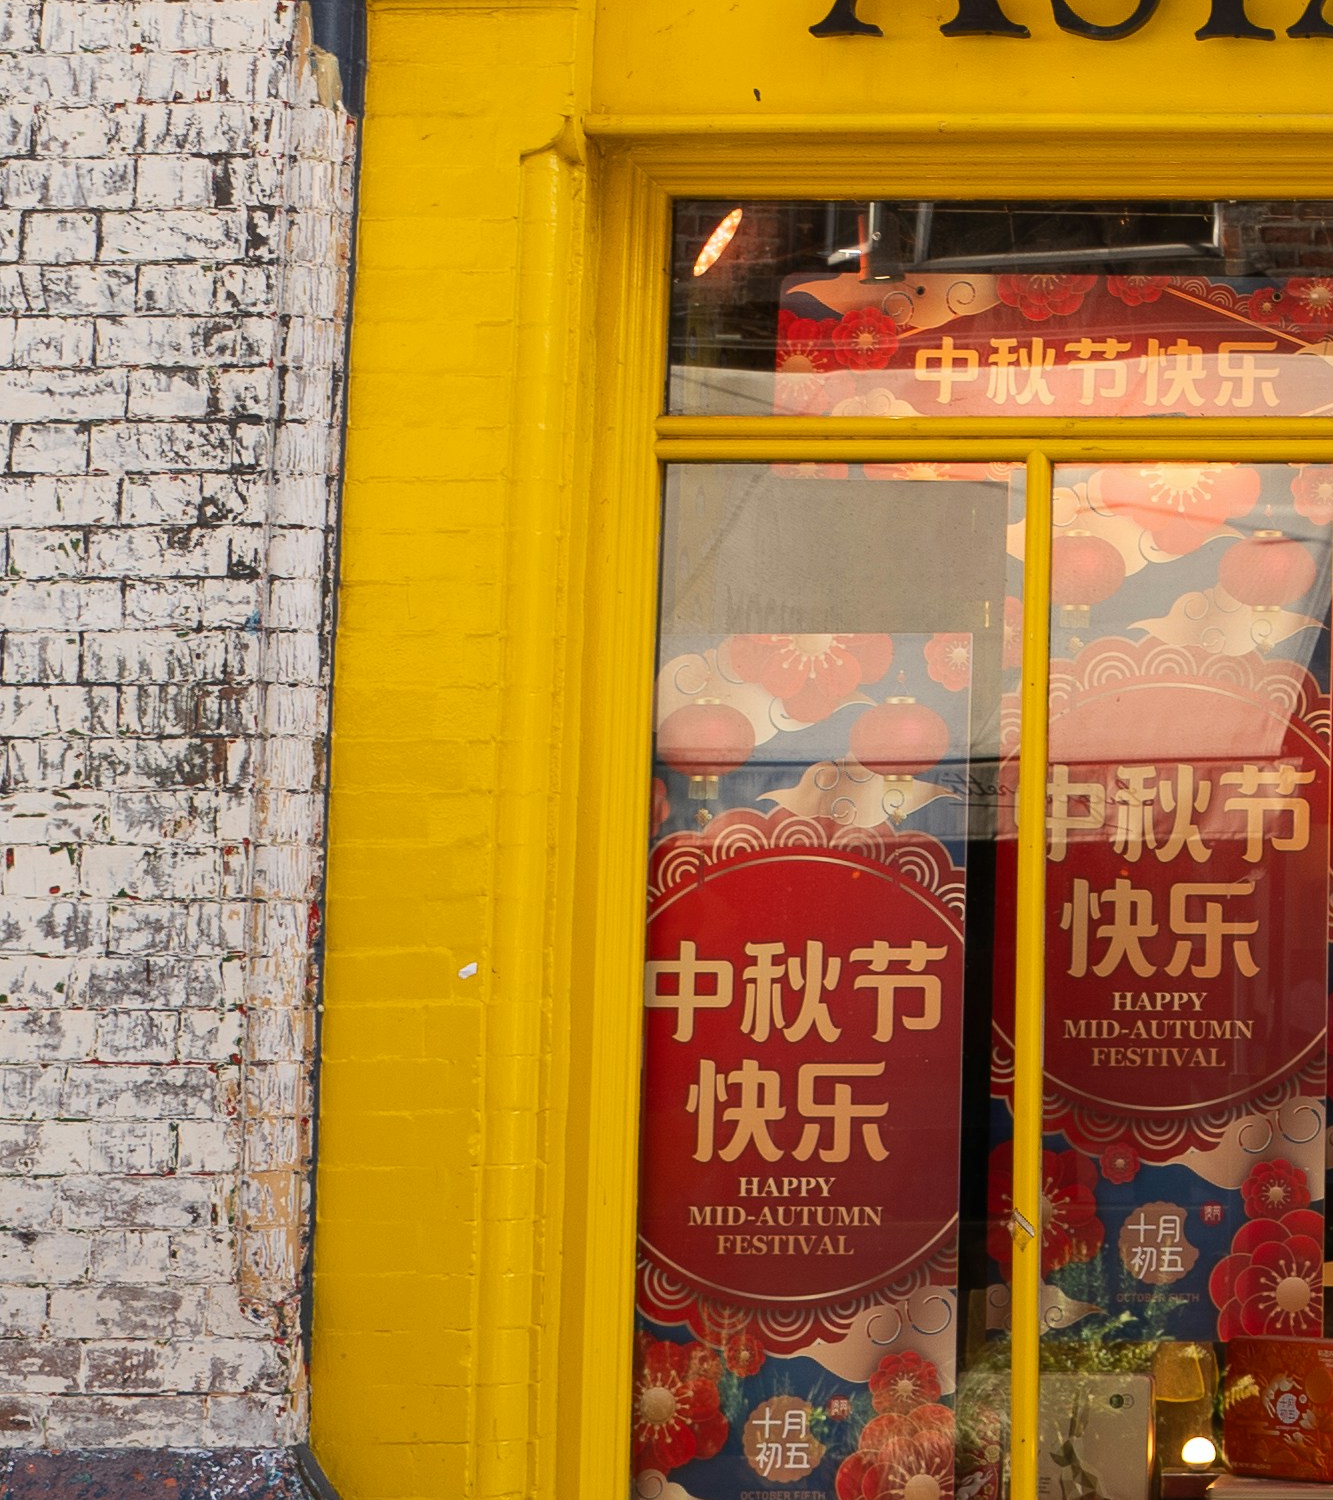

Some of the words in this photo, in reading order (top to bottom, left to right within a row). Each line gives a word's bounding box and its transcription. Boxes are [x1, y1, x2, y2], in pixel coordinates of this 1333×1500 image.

[914, 335, 1281, 408] 中秋节快乐
[1015, 763, 1316, 863] 中秋节
[1059, 877, 1261, 979] 快乐
[644, 940, 948, 1043] 中秋节
[1112, 991, 1208, 1011] HAPPY
[1063, 1019, 1255, 1040] MID-AUTUMN
[1091, 1047, 1226, 1068] FESTIVAL
[685, 1058, 890, 1163] 快乐
[738, 1176, 836, 1197] HAPPY
[688, 1206, 884, 1227] MID-AUTUMN
[1127, 1212, 1181, 1244] 十月
[716, 1234, 854, 1256] FESTIVAL
[1130, 1246, 1185, 1280] 初五
[752, 1407, 806, 1439] 十月
[754, 1441, 811, 1477] 初五
[740, 1490, 791, 1500] OCTOBER
[794, 1490, 826, 1500] FIFTH
